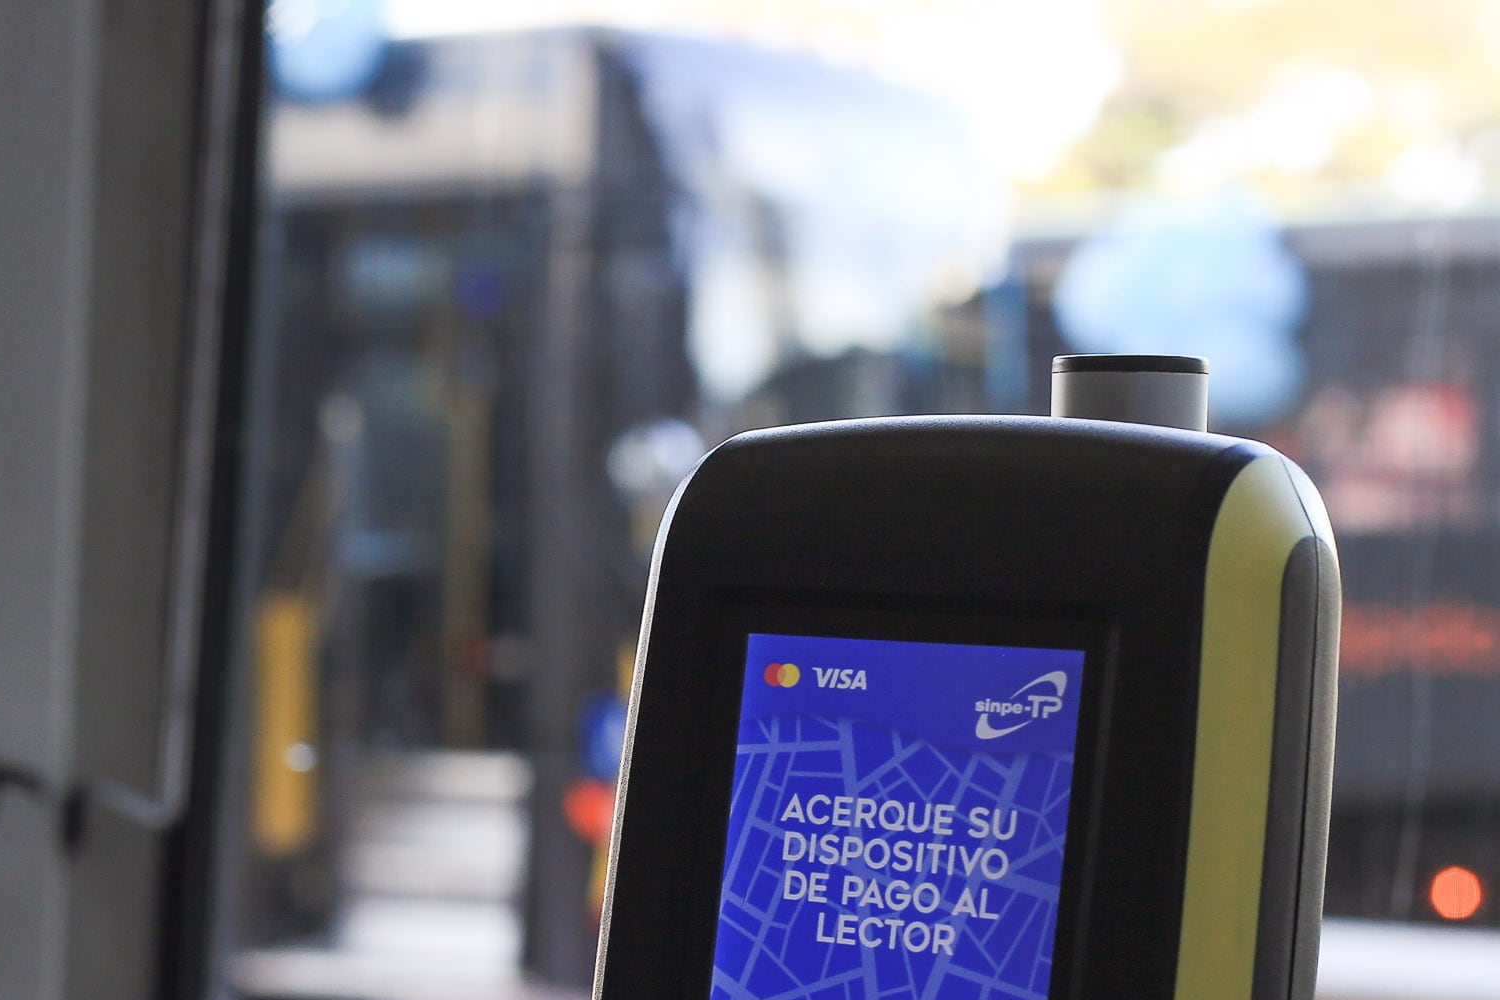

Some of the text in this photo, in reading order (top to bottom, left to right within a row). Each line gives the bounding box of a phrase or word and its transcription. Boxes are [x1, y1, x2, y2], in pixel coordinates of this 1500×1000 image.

[812, 667, 867, 690] VISA
[975, 695, 1063, 719] sinpe-TP
[780, 793, 1018, 841] ACERQUE SU
[782, 830, 1009, 880] DISPOSITIVO
[783, 869, 999, 920] DE PAGO AL
[816, 912, 956, 956] LECTOR
